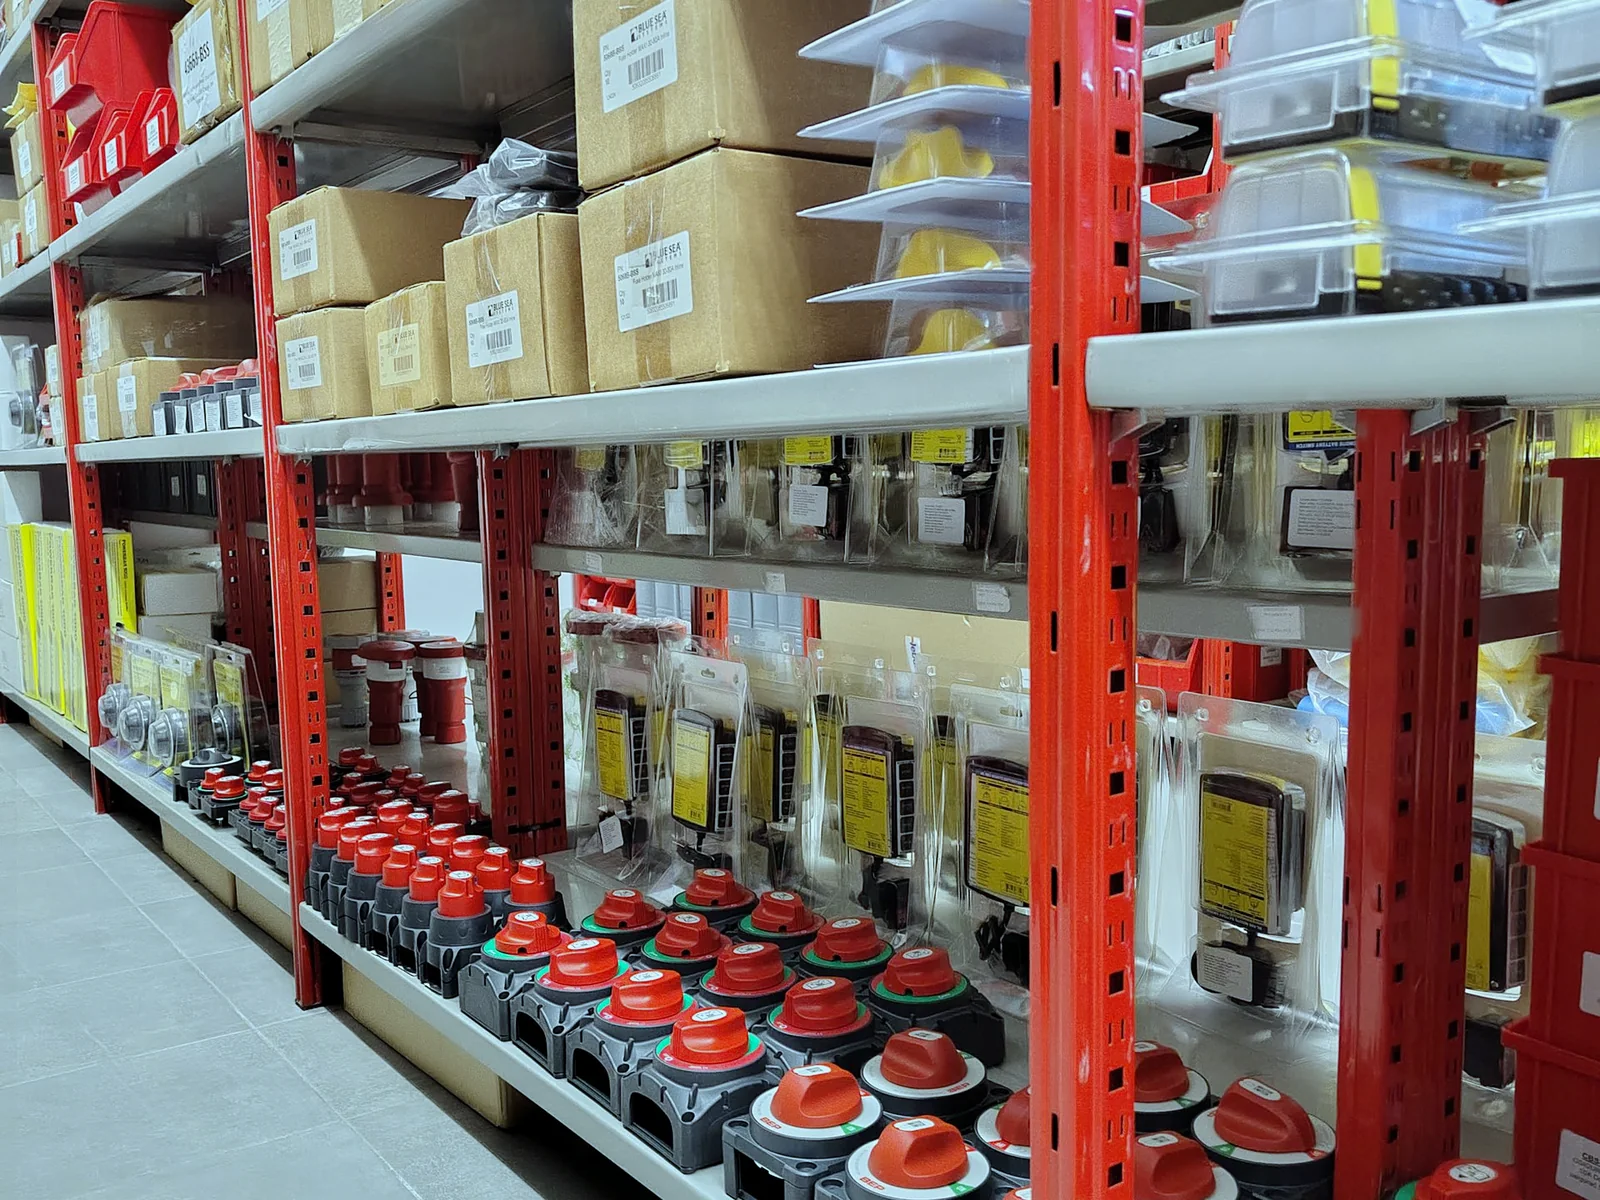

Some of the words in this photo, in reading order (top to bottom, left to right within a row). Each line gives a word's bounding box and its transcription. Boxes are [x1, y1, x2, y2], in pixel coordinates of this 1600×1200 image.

[638, 17, 653, 34] BLUE
[654, 10, 668, 24] SEA
[669, 242, 681, 254] SEA
[493, 301, 504, 312] BLUE
[504, 298, 514, 308] SEA
[859, 1176, 885, 1191] BEP
